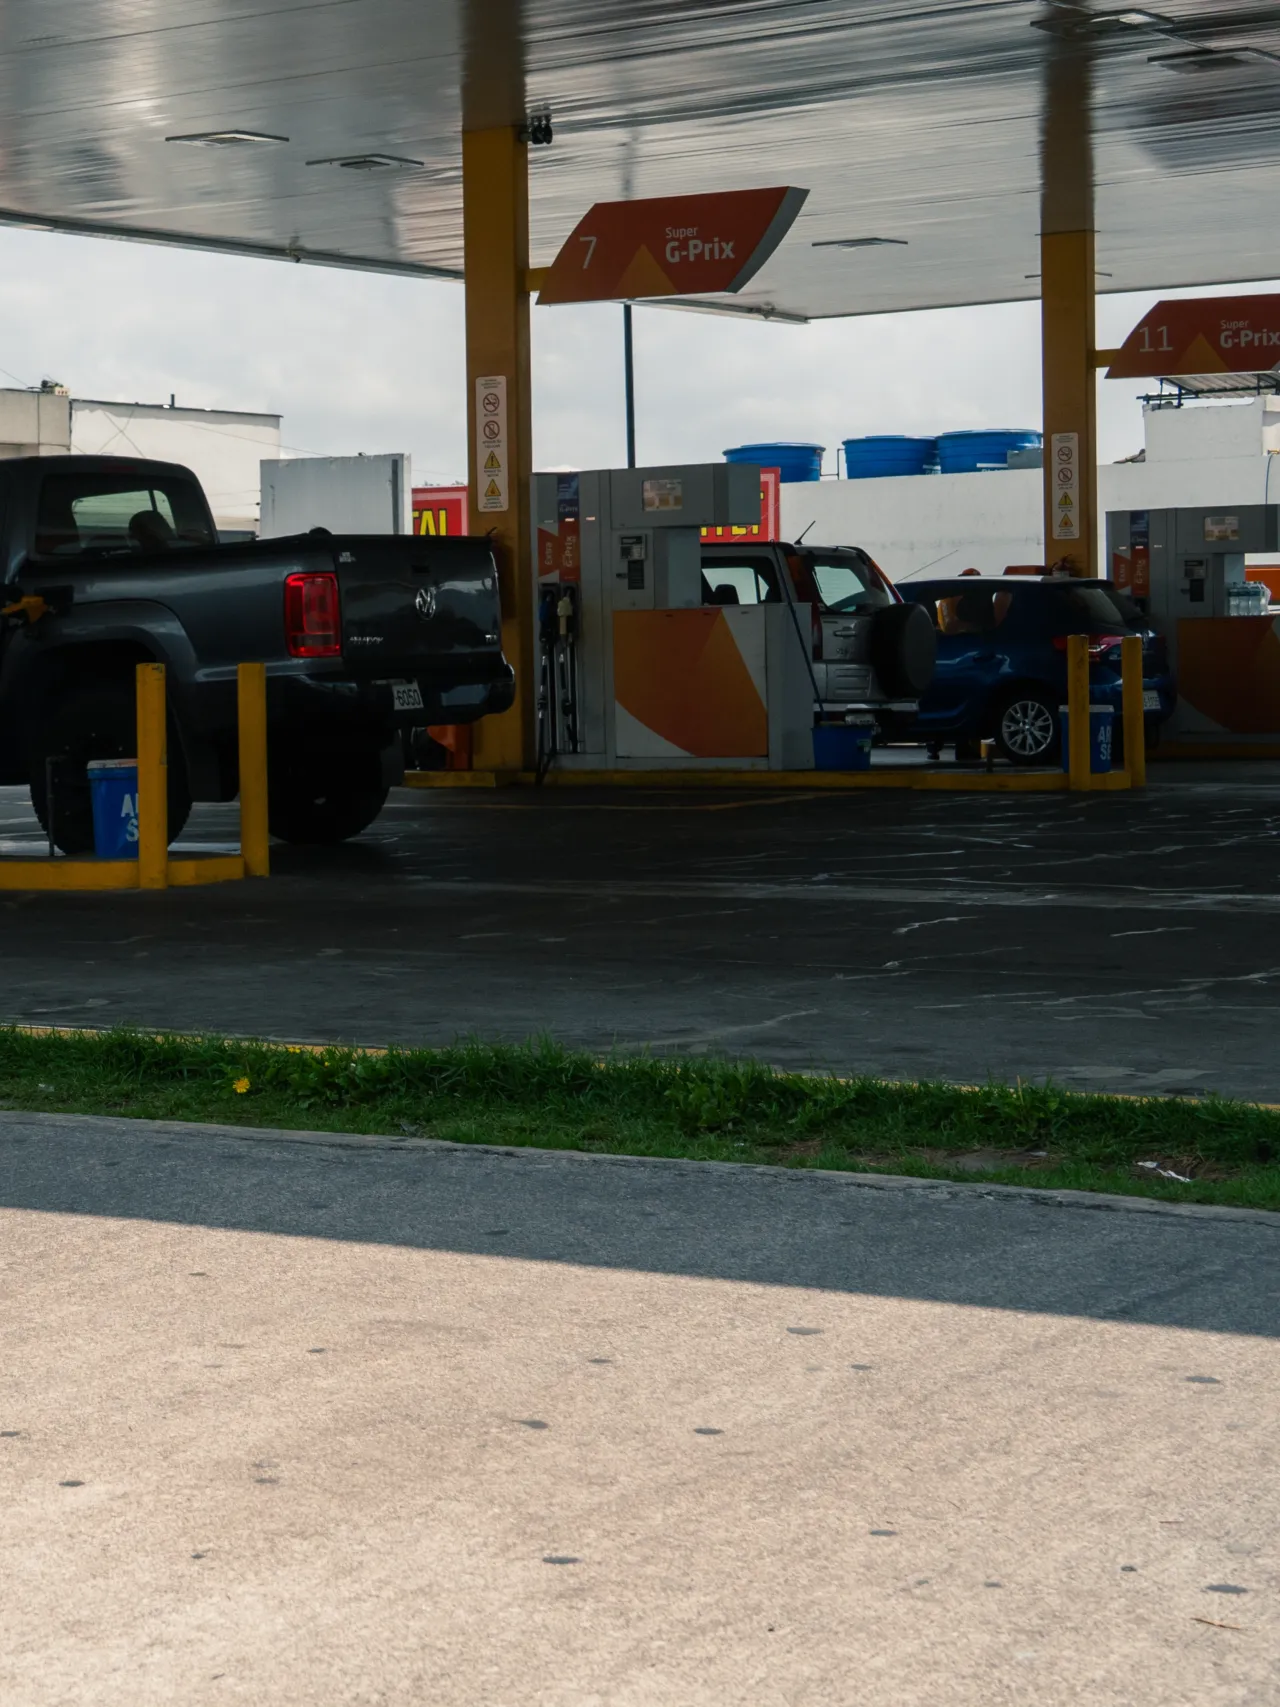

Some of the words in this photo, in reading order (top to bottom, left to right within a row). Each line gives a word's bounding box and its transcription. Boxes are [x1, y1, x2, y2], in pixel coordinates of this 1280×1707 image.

[665, 226, 698, 240] Super
[579, 236, 597, 269] 7
[665, 237, 736, 264] G-Prix
[1220, 319, 1249, 330] Super
[1138, 325, 1174, 353] 11
[1219, 329, 1280, 349] G-Prix
